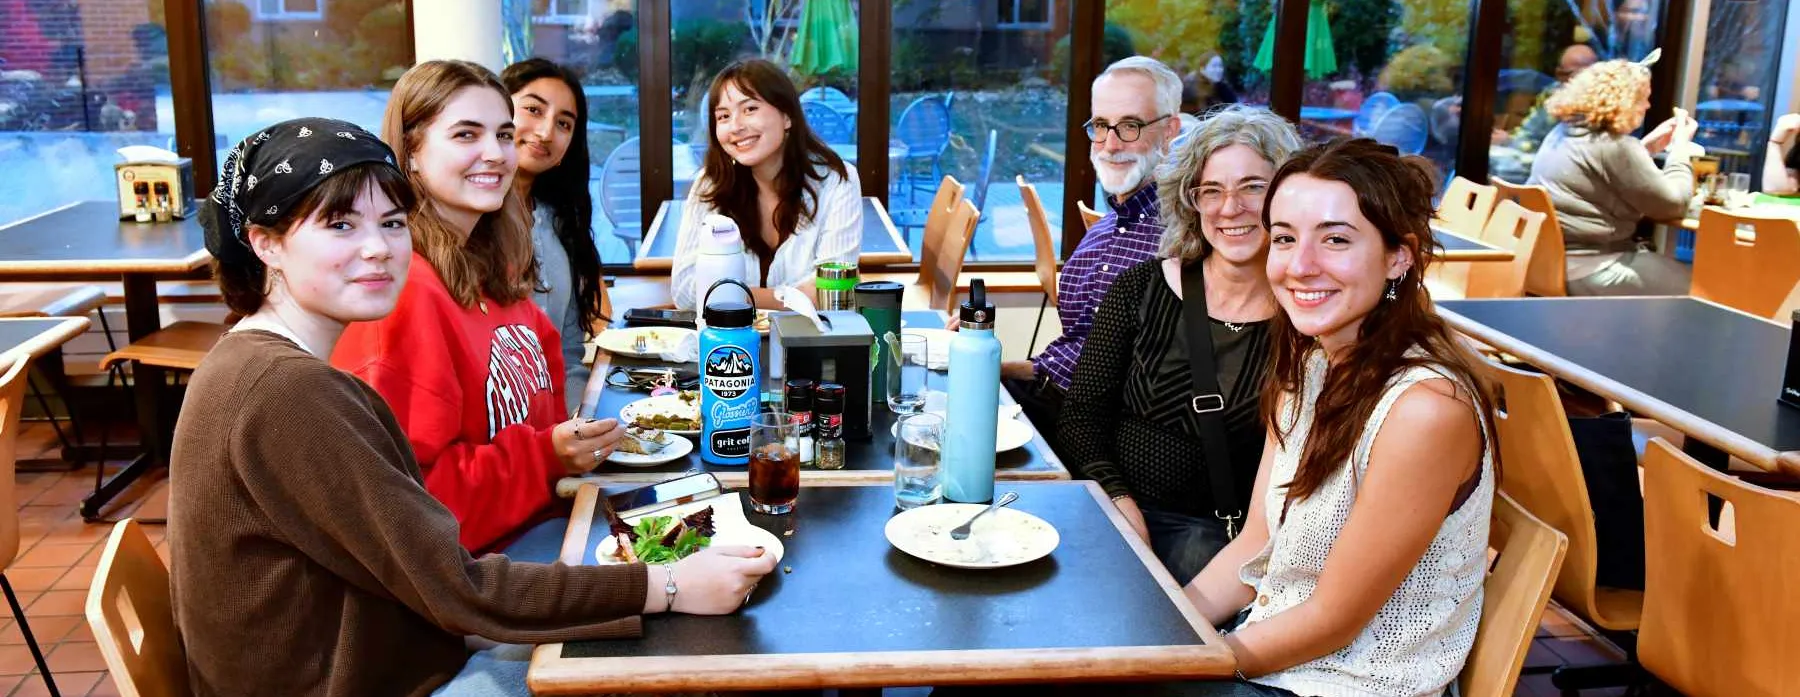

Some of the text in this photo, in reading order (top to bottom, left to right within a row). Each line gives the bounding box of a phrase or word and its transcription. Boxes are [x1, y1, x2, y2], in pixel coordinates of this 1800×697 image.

[704, 377, 756, 387] PATAGONIA
[717, 437, 735, 449] grit
[736, 435, 751, 446] cof
